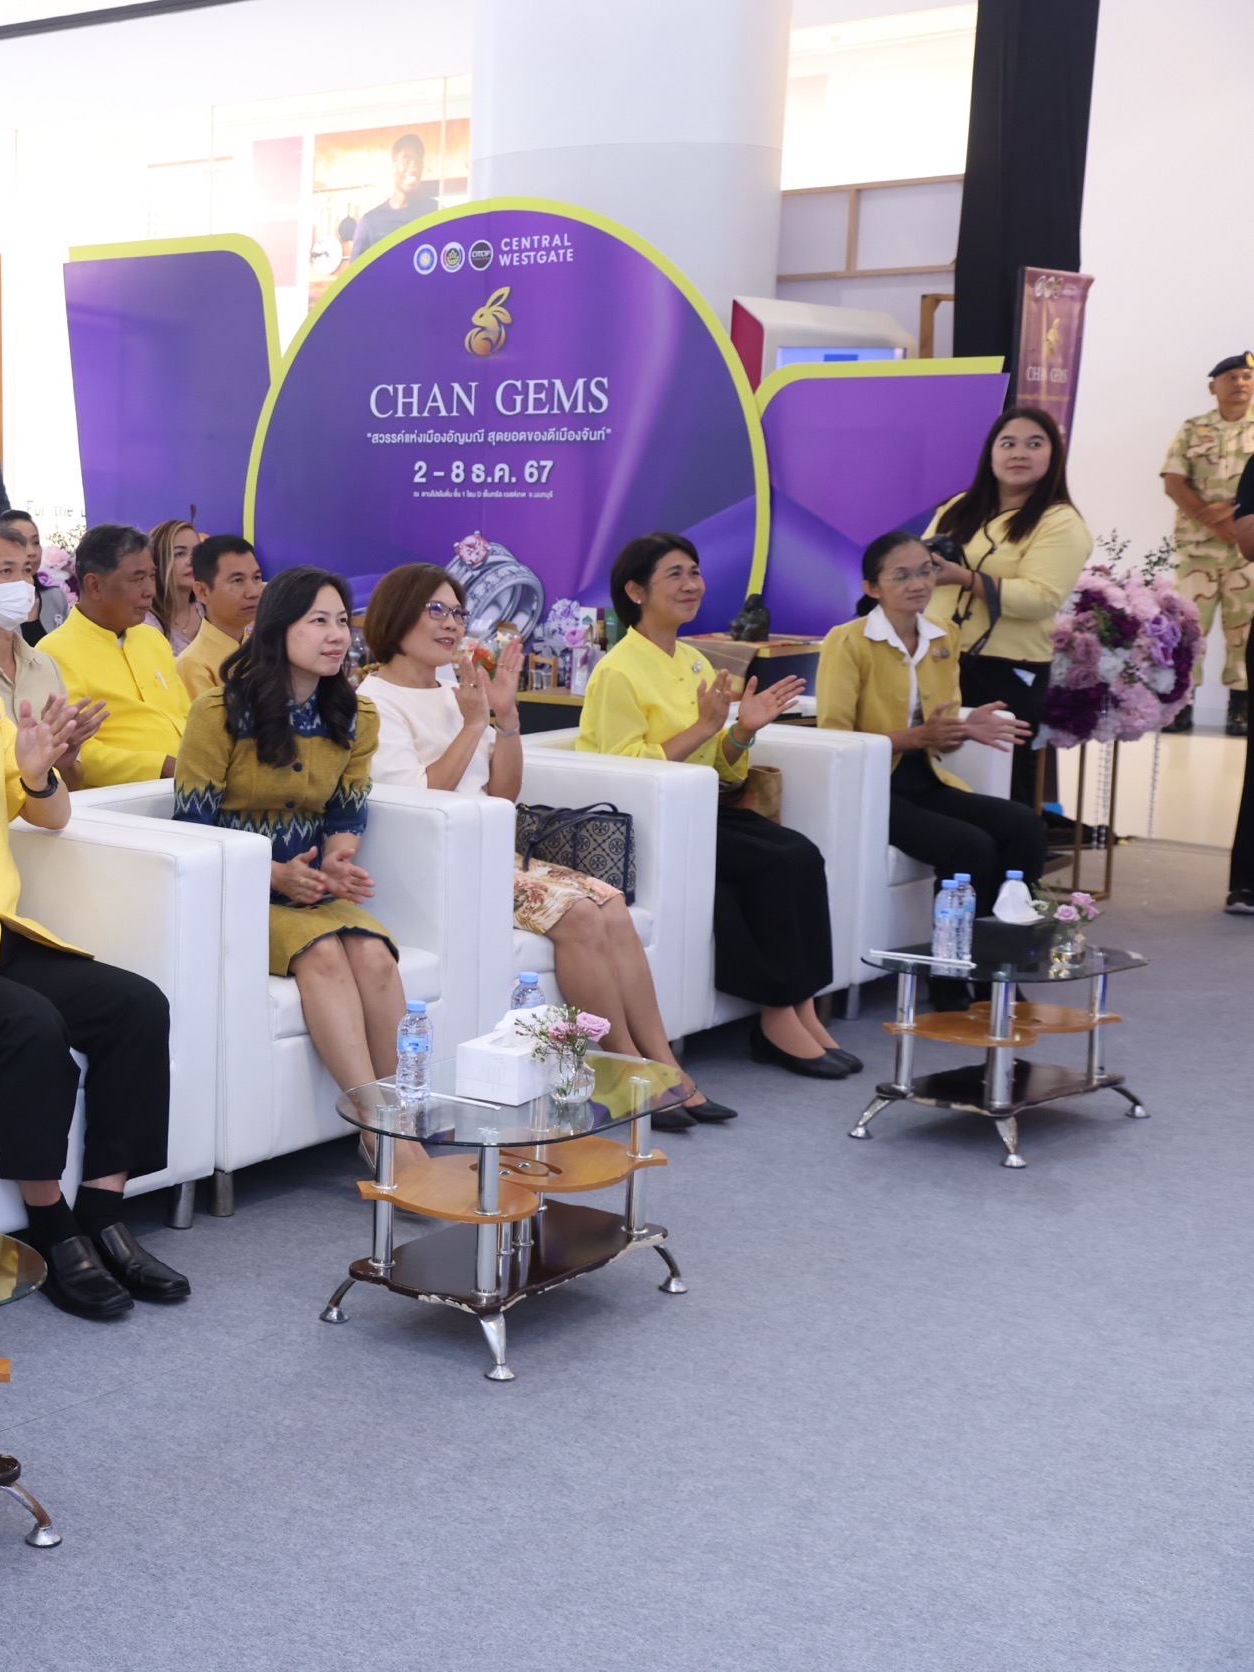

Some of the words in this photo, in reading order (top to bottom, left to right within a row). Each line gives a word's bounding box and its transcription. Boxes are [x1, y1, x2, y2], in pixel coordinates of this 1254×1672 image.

[500, 233, 572, 251] CENTRAL
[471, 249, 491, 258] OTOP
[498, 249, 574, 267] WESTGATE
[368, 381, 479, 419] CHAN
[494, 376, 610, 416] GEMS
[413, 460, 427, 483] 2
[450, 460, 466, 484] 8
[471, 463, 518, 484] ธ.ค.
[524, 460, 554, 484] 67
